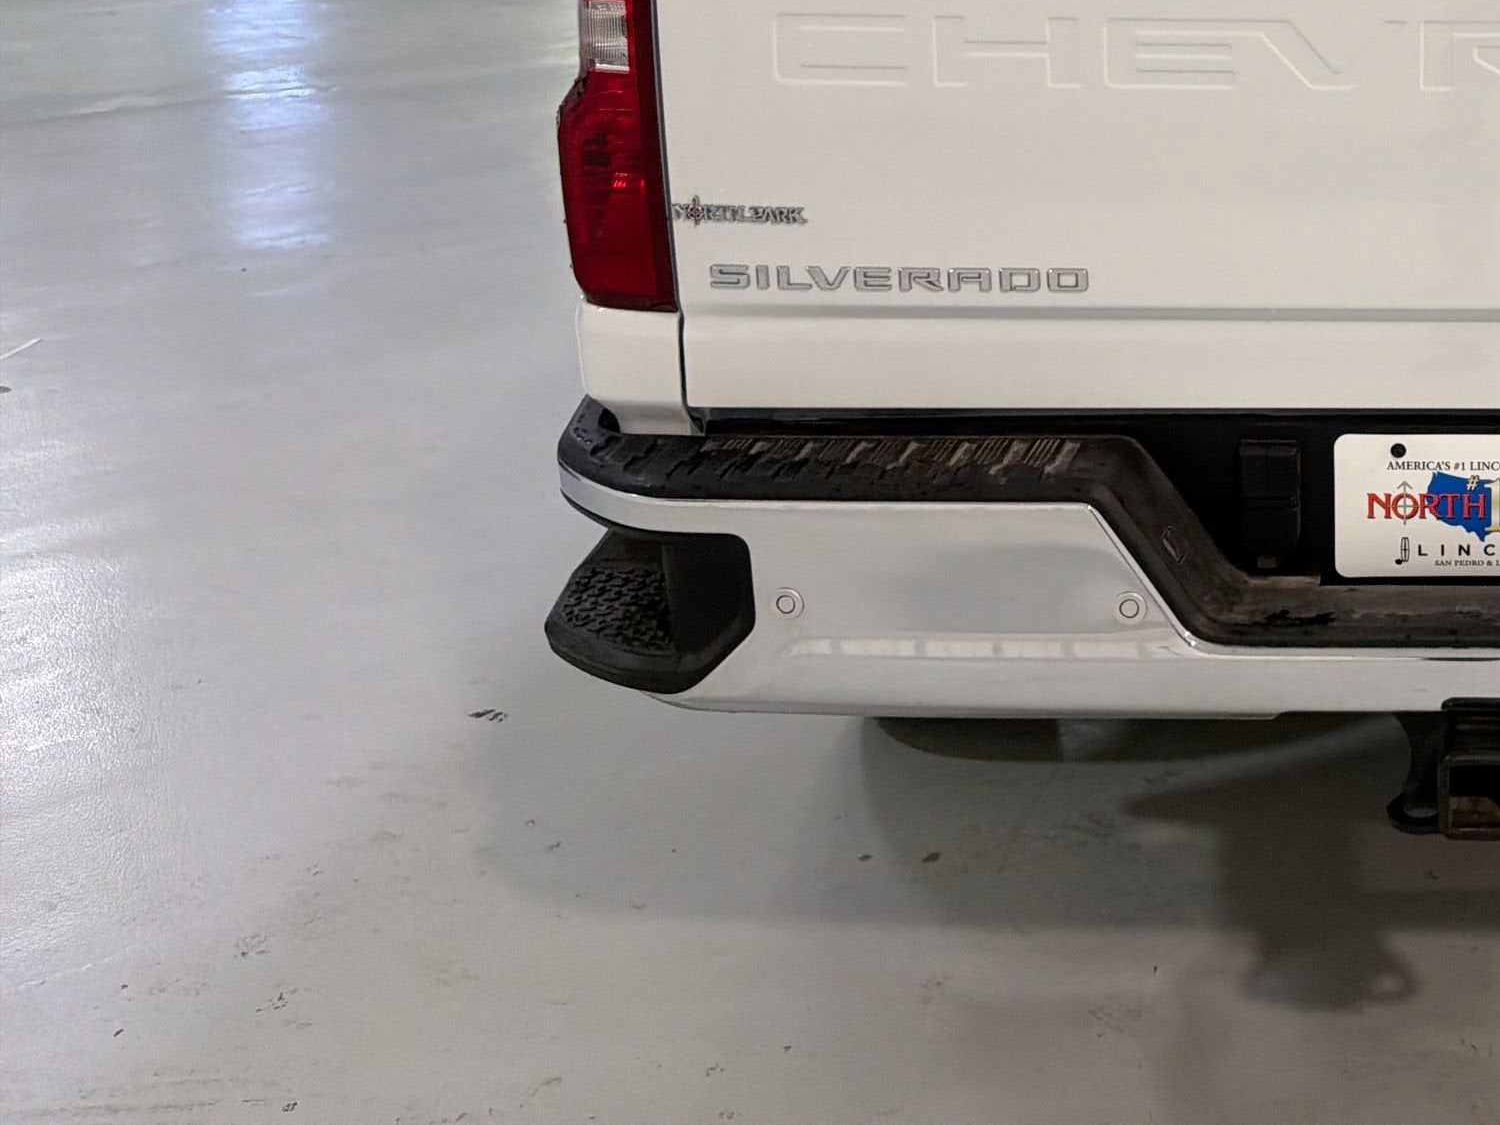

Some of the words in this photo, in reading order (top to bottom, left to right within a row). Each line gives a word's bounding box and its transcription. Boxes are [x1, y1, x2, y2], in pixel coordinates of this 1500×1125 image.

[748, 205, 808, 224] PARK
[709, 263, 1090, 293] SILVERADO
[1386, 460, 1452, 472] AMERICA'S
[1453, 461, 1466, 472] #1
[1366, 491, 1487, 521] NORTH
[1434, 559, 1453, 568] SAN
[1454, 559, 1485, 568] PEDRO
[1486, 559, 1494, 568] &
